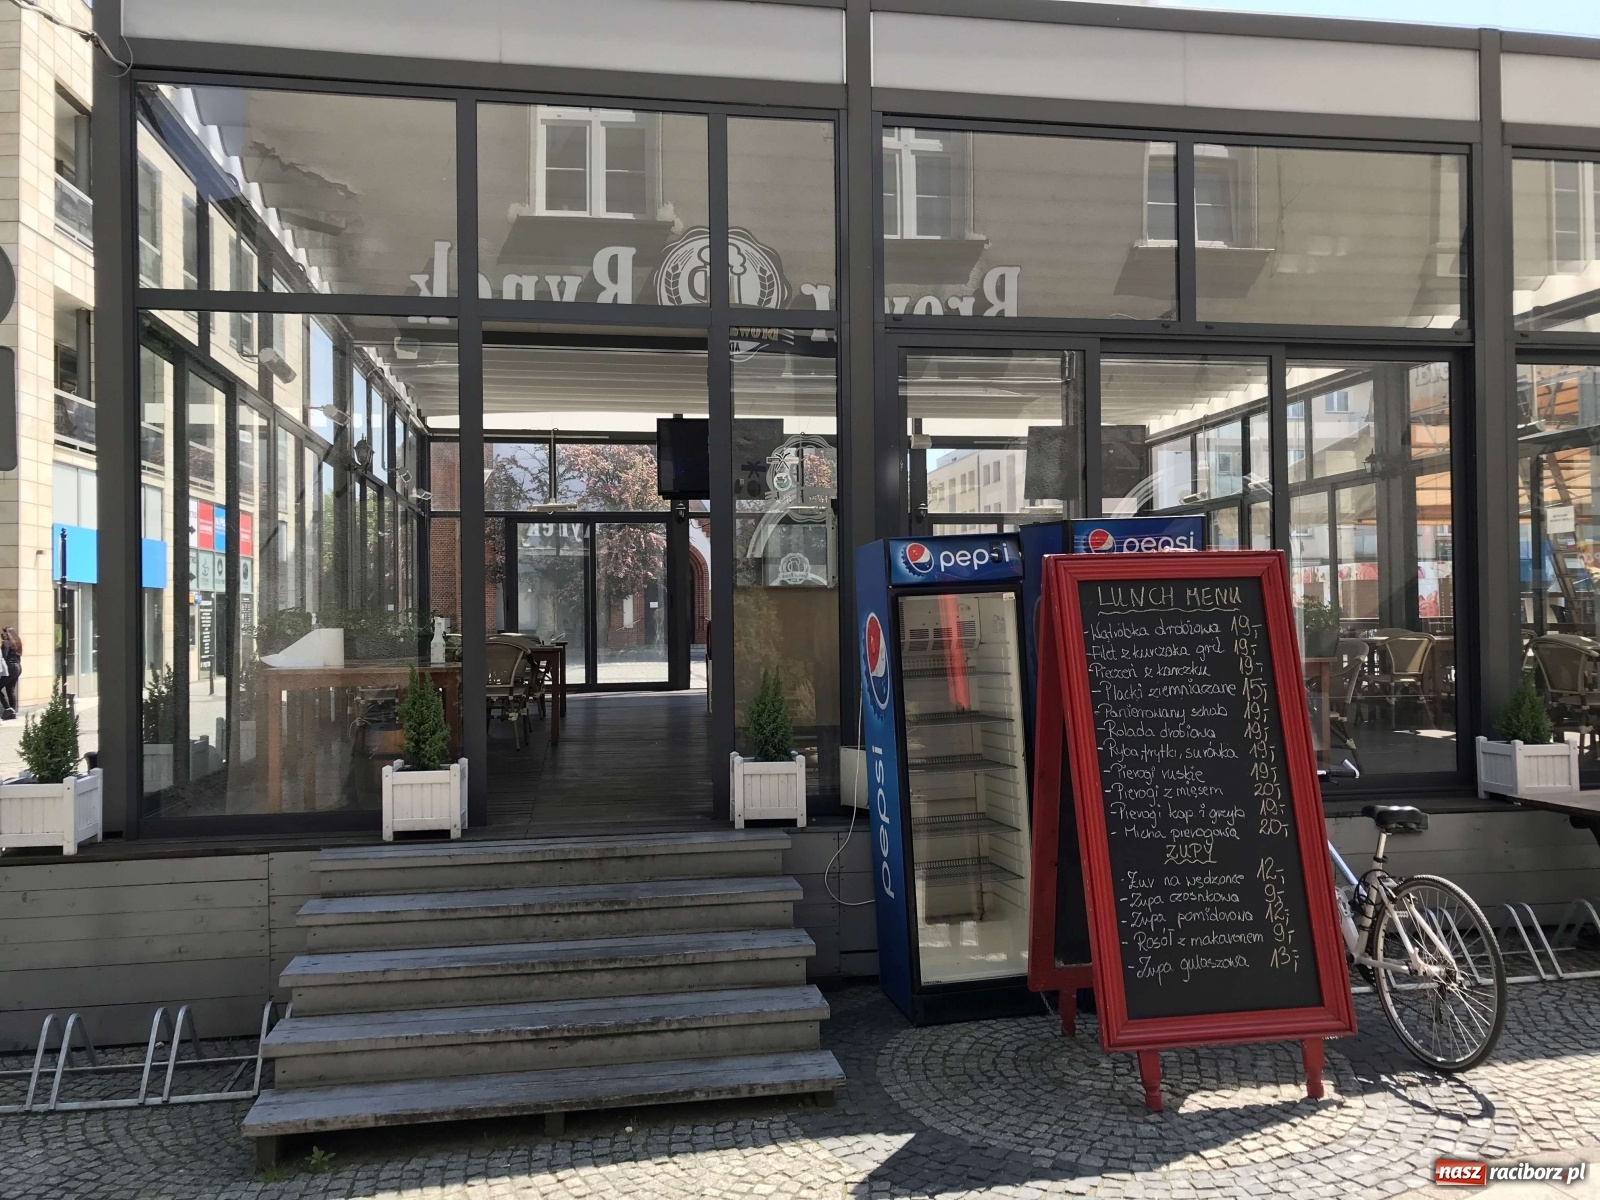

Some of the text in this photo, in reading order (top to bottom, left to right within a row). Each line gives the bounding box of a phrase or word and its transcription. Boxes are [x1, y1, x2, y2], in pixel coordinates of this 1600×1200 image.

[1098, 586, 1242, 607] LUNCH MENU
[1154, 618, 1222, 635] drobiowa
[1160, 721, 1216, 739] drobiowa
[1161, 766, 1205, 783] ruskie
[1164, 788, 1173, 798] z
[1199, 803, 1206, 818] i
[872, 745, 895, 899] pepsi
[1165, 842, 1214, 862] ZUPY
[1164, 875, 1181, 887] na
[1169, 891, 1240, 903] czosnkowa
[1177, 906, 1254, 929] pomidorowa
[1177, 937, 1186, 947] z
[1190, 930, 1264, 947] makaronem
[1180, 954, 1250, 983] gulaszowa
